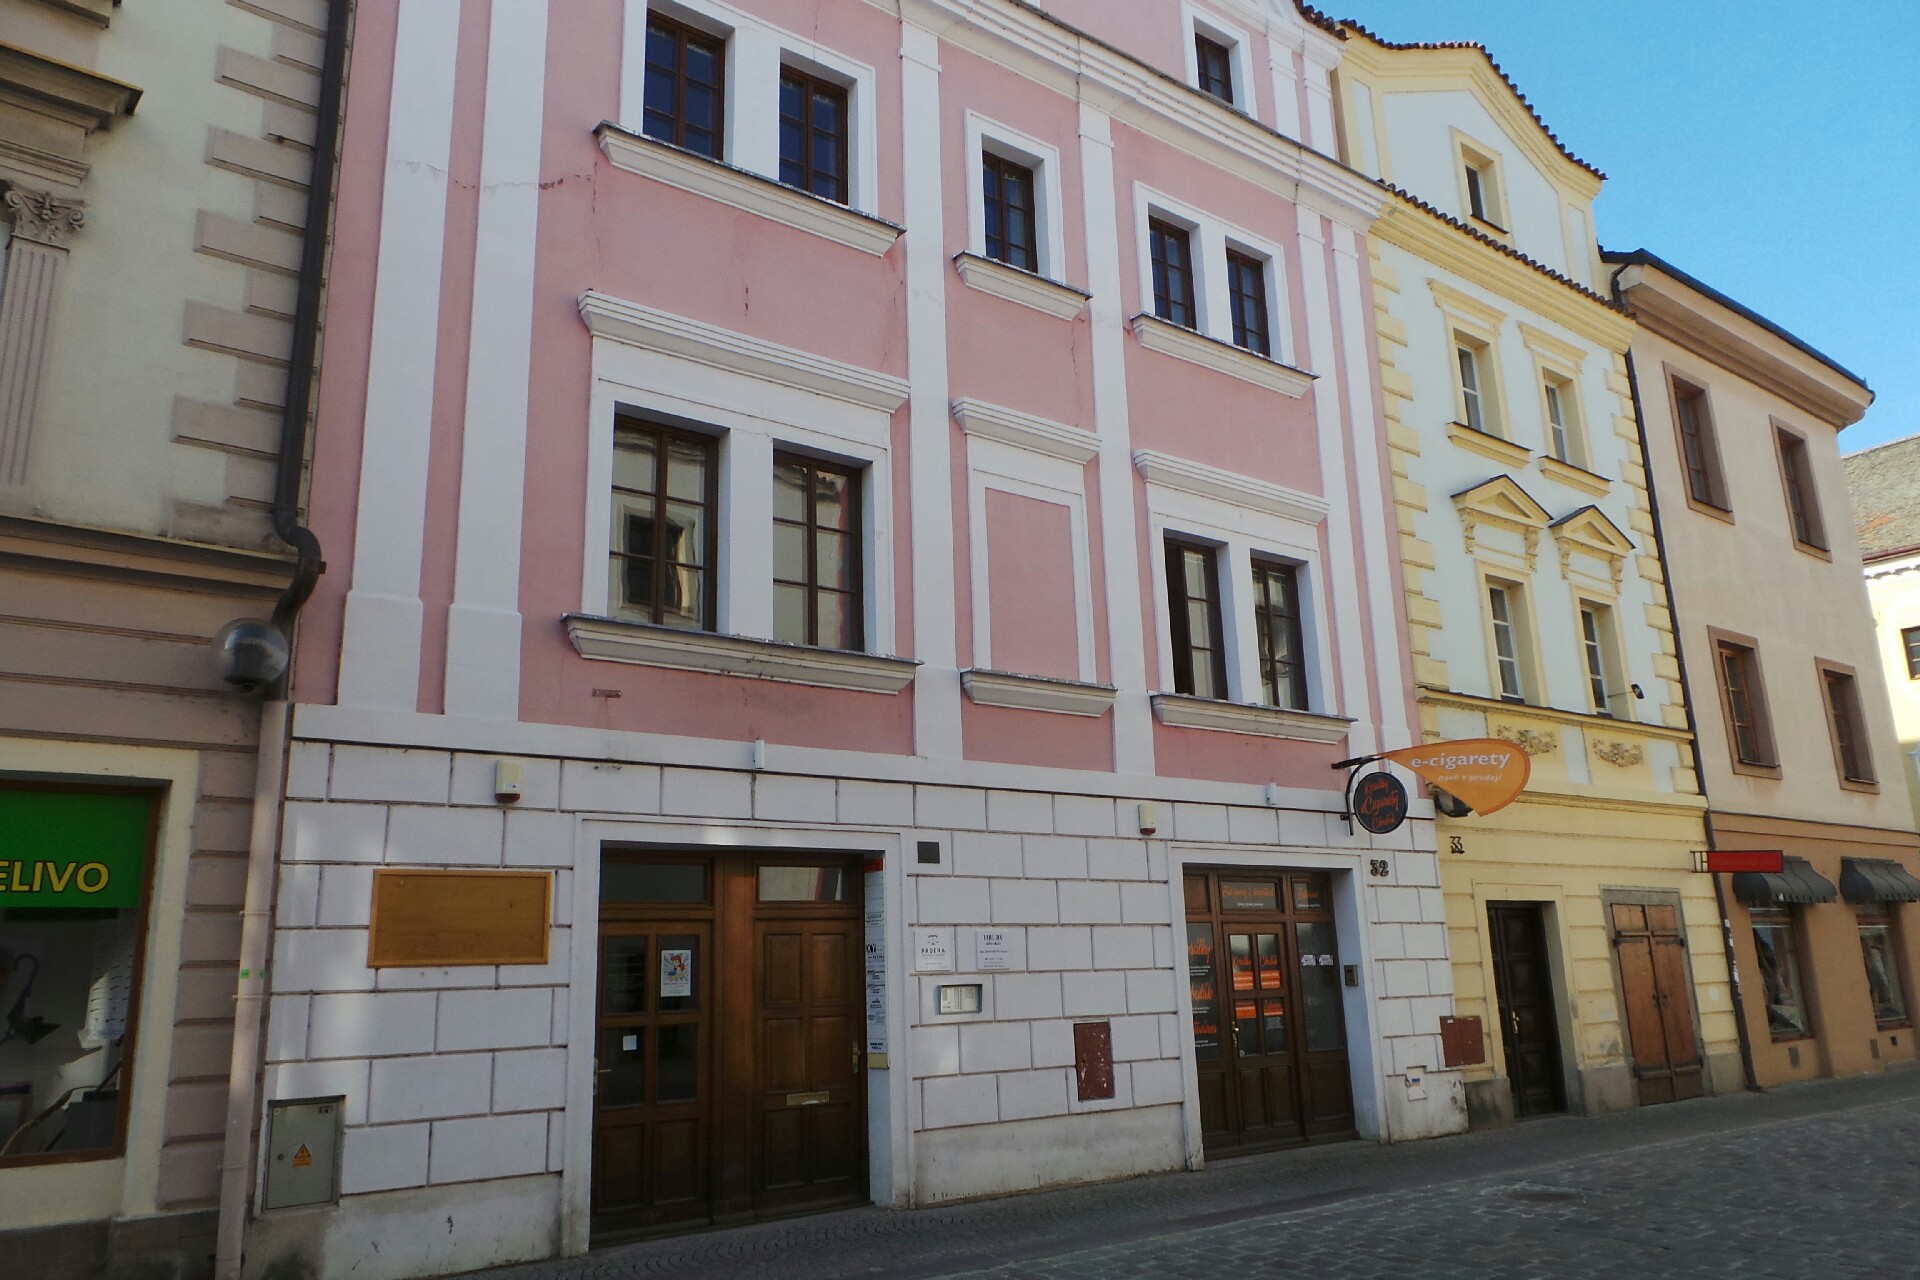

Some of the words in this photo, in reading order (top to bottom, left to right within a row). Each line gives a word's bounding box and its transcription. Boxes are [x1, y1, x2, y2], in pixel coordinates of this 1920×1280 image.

[1411, 752, 1511, 770] e-cigarety
[1450, 836, 1465, 854] 33
[0, 859, 110, 894] ELIVO
[1370, 859, 1389, 877] 32
